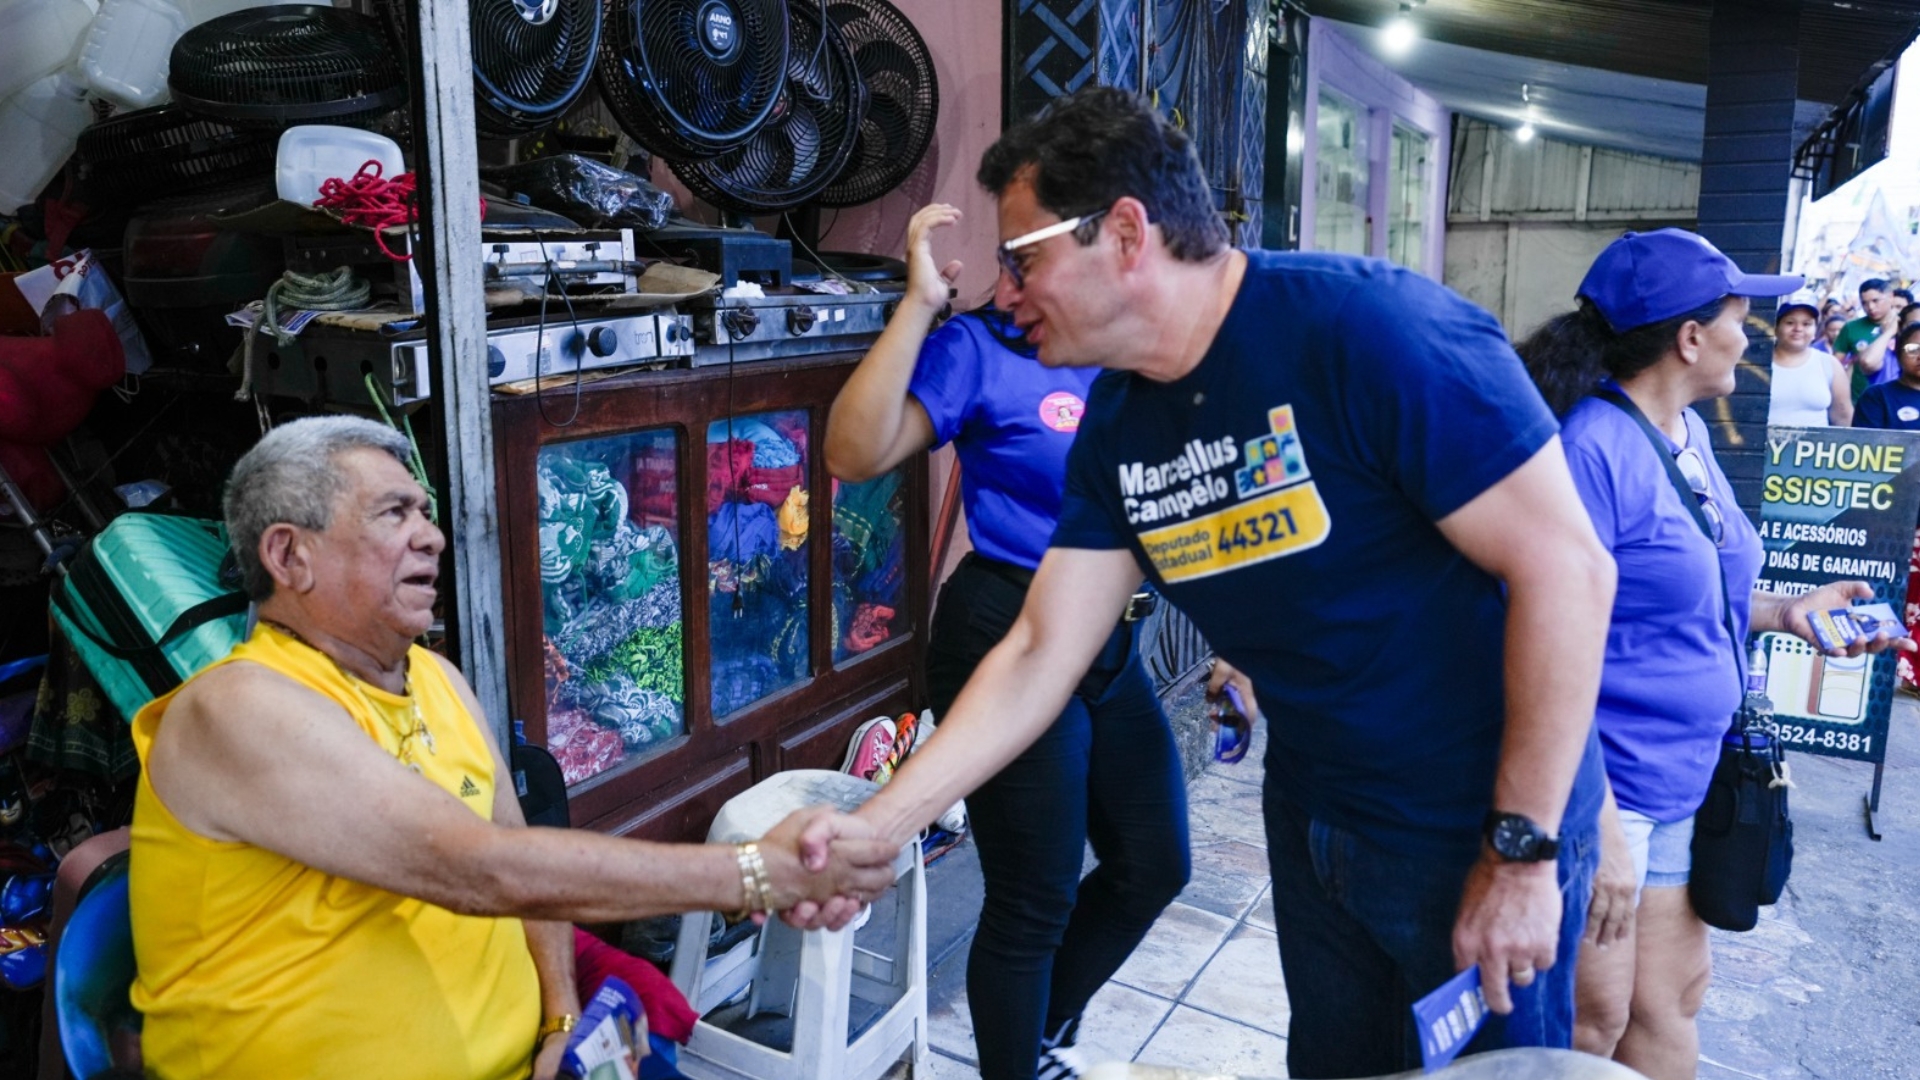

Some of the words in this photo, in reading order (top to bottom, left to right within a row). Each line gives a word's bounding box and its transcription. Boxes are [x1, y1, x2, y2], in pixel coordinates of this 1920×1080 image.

[709, 13, 732, 25] ARNO
[1119, 436, 1238, 496] Marcellus
[1769, 438, 1788, 465] Y
[1795, 440, 1904, 473] PHONE
[1125, 474, 1229, 524] Campêlo
[1763, 475, 1893, 510] SSISTEC
[1146, 530, 1210, 555] Deputado
[1218, 508, 1298, 555] 44321
[1772, 522, 1781, 538] E
[1783, 523, 1867, 547] ACESSÓRIOS
[1769, 551, 1799, 570] DIAS
[1802, 554, 1820, 571] DE
[1823, 556, 1896, 583] GARANTIA)
